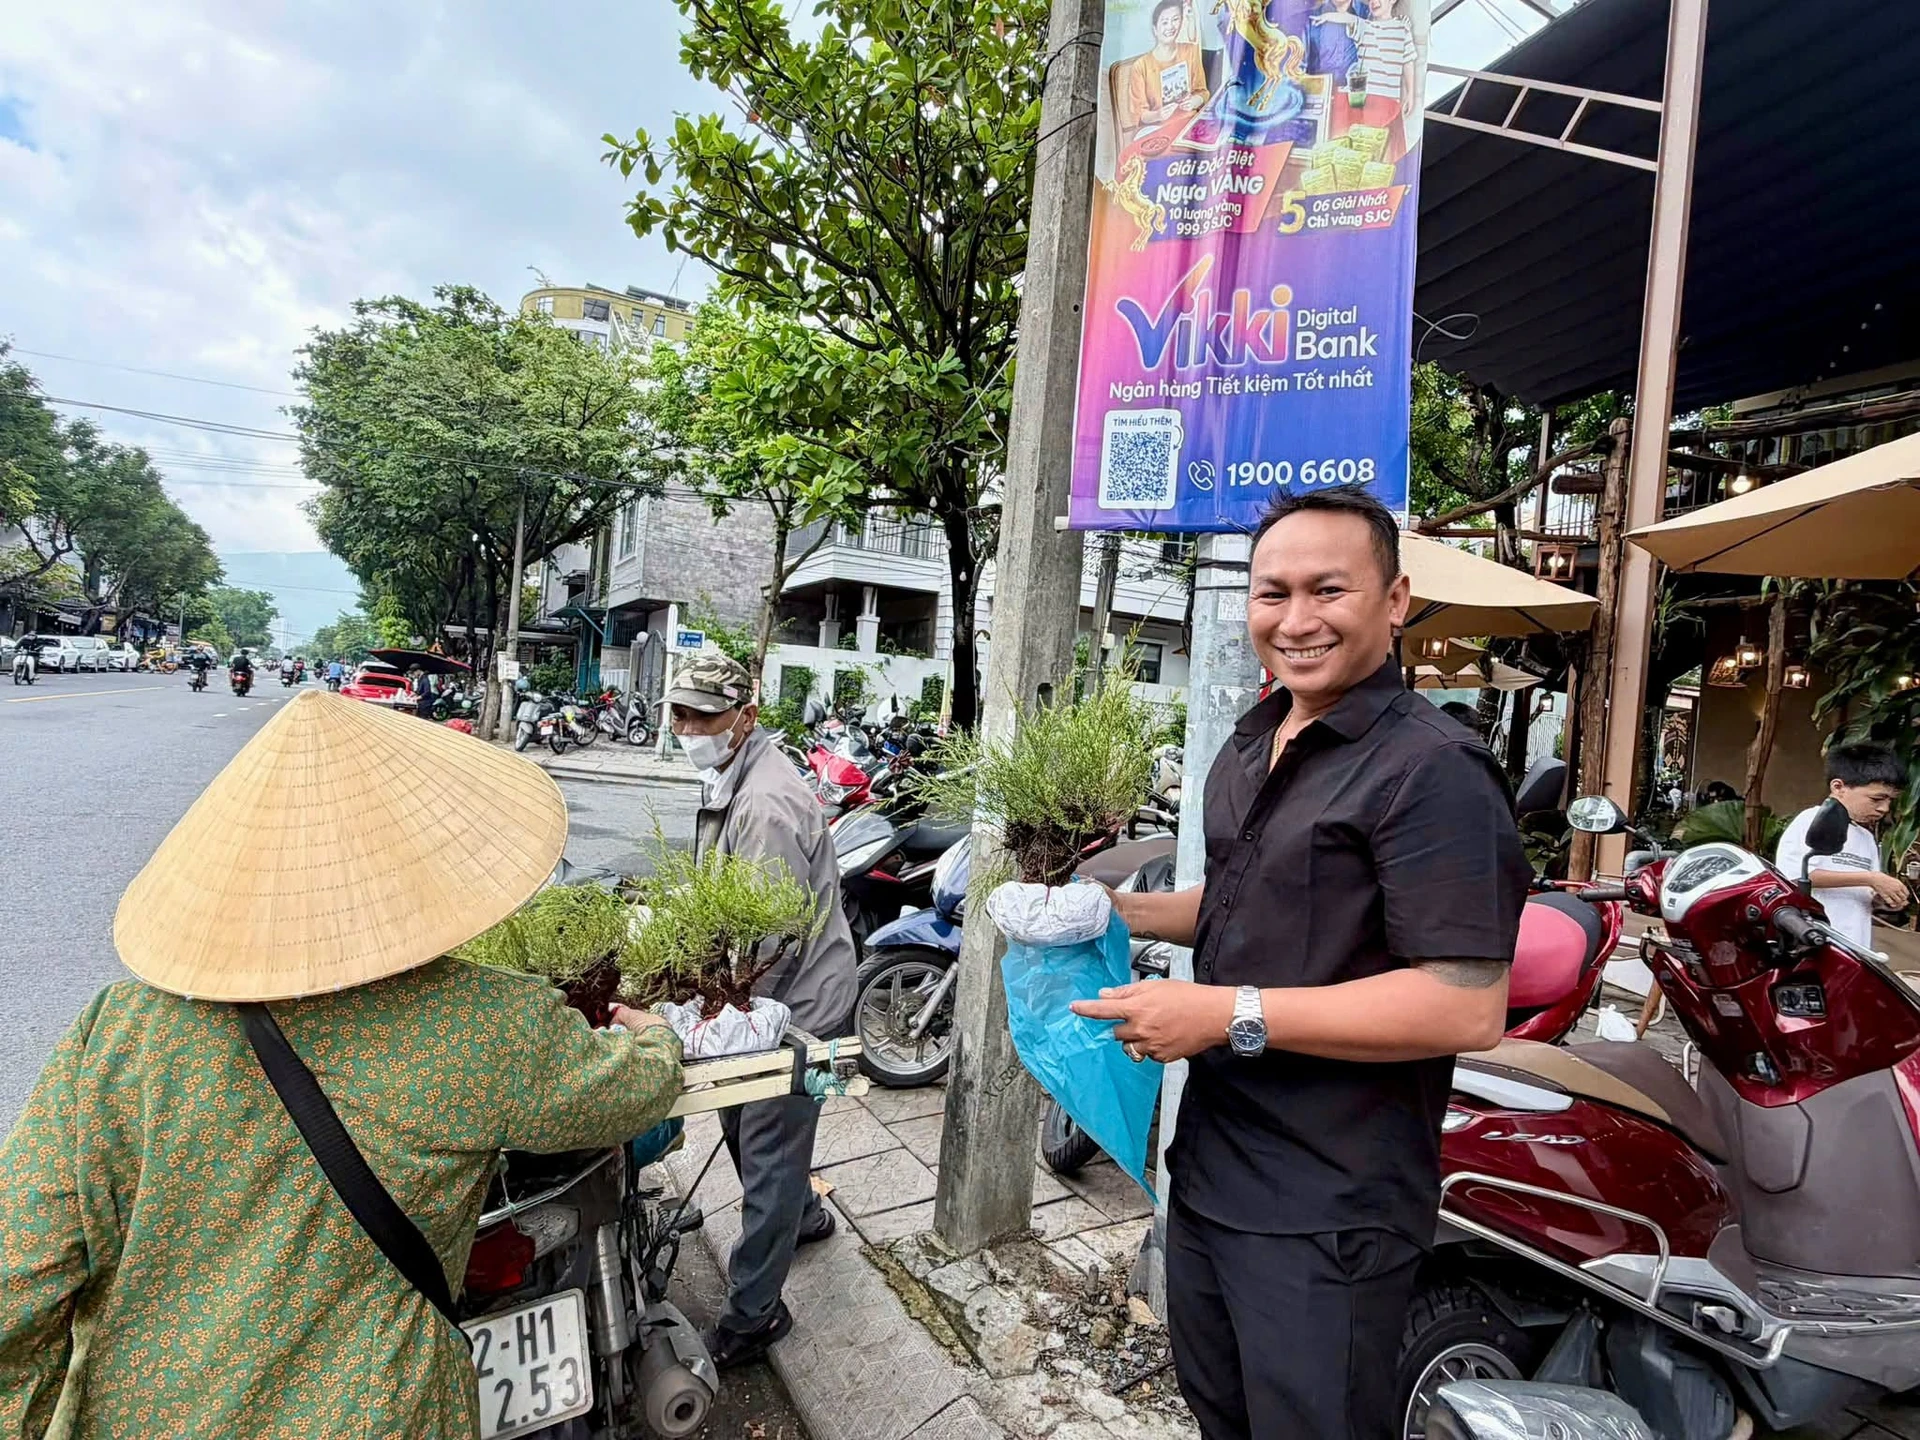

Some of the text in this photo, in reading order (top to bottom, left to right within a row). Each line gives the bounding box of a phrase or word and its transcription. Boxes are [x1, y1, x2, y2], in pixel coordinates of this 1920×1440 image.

[1167, 150, 1255, 177] Giải Đặc Biệt
[1156, 167, 1264, 205] Ngựa VÀNG
[1169, 198, 1242, 223] 10 lượng vàng
[1278, 190, 1306, 234] 5
[1313, 190, 1388, 212] 06 Giải Nhất
[1176, 215, 1232, 235] 999.9 SJC
[1307, 209, 1391, 228] Chỉ vàng SJC
[1116, 253, 1293, 371] Vikki
[1297, 305, 1357, 330] Digital
[1295, 326, 1378, 360] Bank
[1109, 365, 1374, 402] Ngân hàng Tiết kiệm Tốt nhất
[1113, 415, 1128, 427] TÌM
[1149, 415, 1173, 427] THÊM
[1226, 458, 1375, 487] 1900 6608
